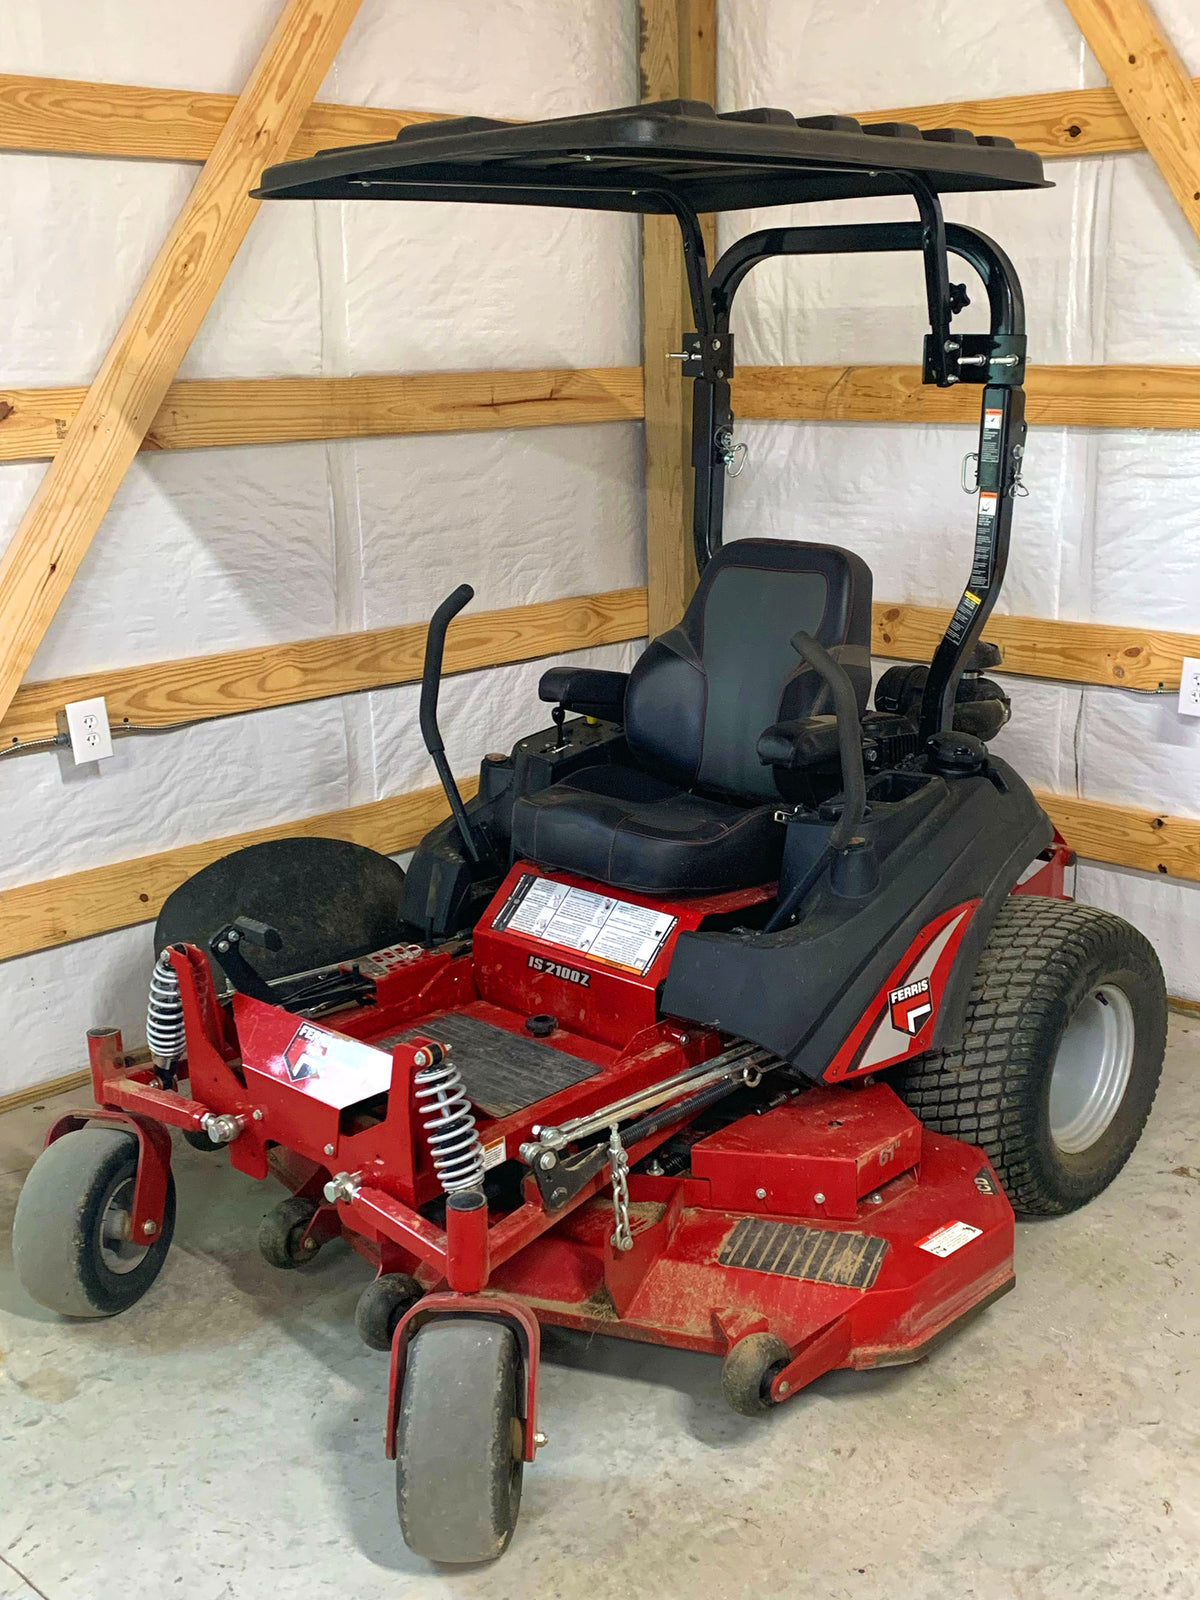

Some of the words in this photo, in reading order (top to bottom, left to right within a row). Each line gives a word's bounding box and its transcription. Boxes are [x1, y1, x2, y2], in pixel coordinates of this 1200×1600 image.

[528, 956, 544, 970] IS
[545, 961, 590, 987] 2100Z
[891, 980, 928, 1004] FERRIS
